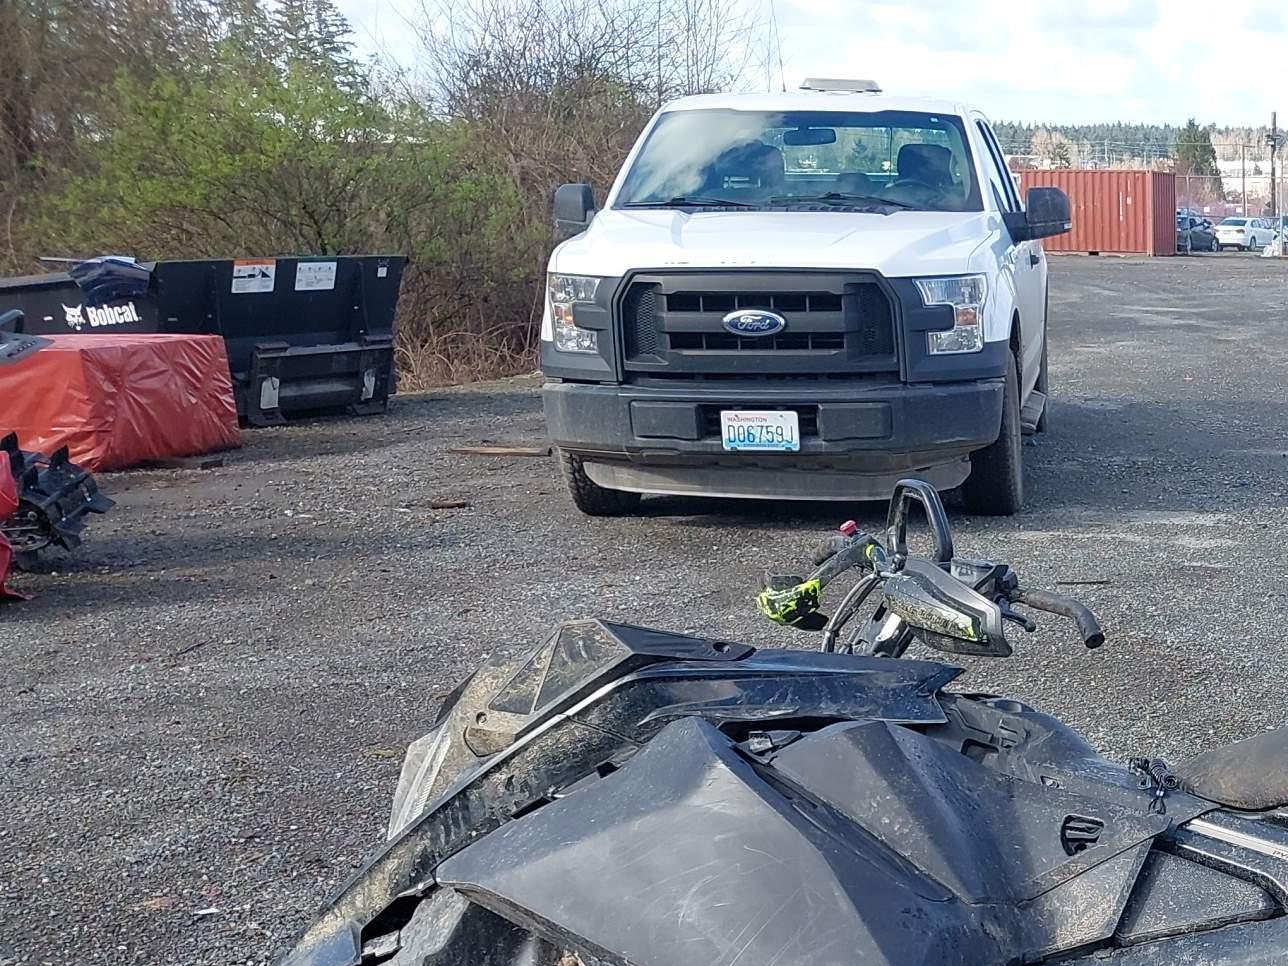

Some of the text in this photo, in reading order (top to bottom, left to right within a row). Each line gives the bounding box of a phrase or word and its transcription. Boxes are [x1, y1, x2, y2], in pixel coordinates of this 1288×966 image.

[86, 301, 139, 327] Bobcat
[737, 314, 770, 331] Ford
[727, 415, 768, 423] WASHINGTON
[727, 424, 794, 444] D06759J
